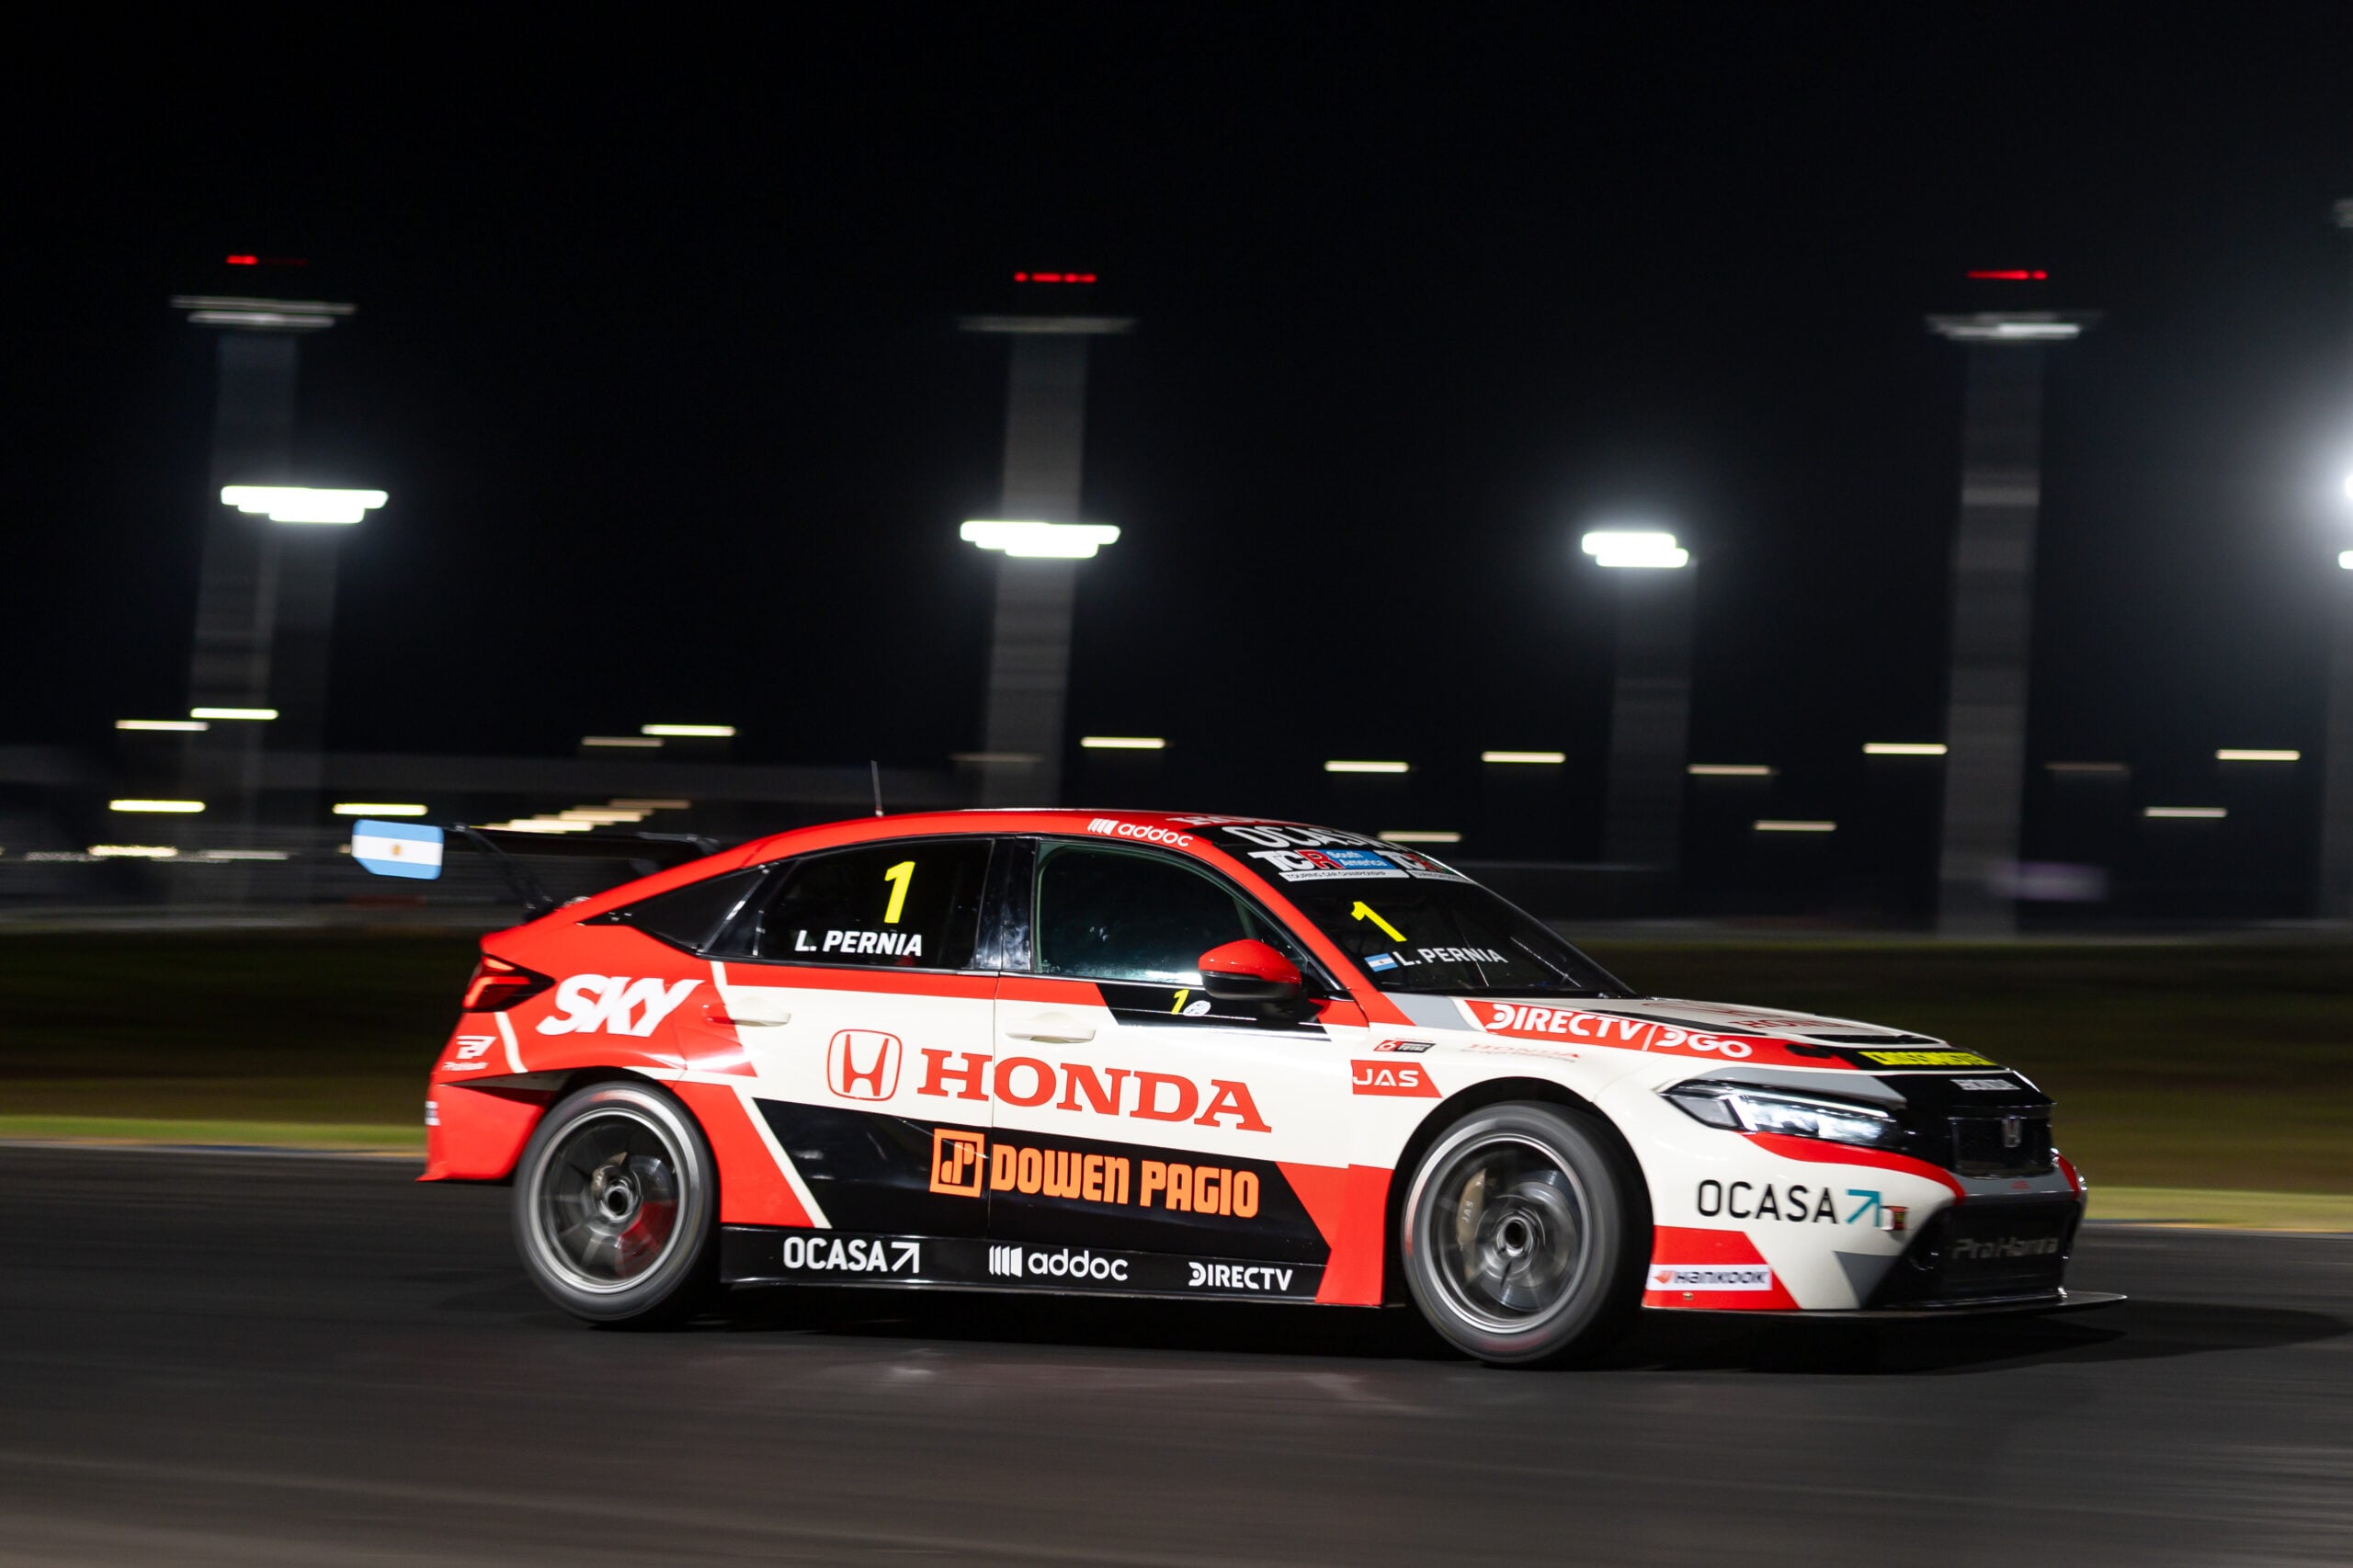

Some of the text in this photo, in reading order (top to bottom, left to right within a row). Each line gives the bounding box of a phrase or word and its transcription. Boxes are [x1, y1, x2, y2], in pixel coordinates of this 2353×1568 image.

[1118, 824, 1193, 846] addoc
[884, 860, 916, 925] 1
[1350, 901, 1407, 942] 1
[794, 929, 923, 957] L. PERNIA
[1392, 948, 1509, 966] L. PERNIA
[536, 973, 705, 1038] SKY
[1171, 988, 1189, 1016] 1
[1485, 1003, 1646, 1041] DIRECTV
[917, 1048, 1272, 1133] HONDA
[1353, 1068, 1419, 1088] JAS
[990, 1143, 1259, 1219] DOWEN PAGIO
[1698, 1179, 1838, 1224] OCASA
[783, 1236, 889, 1272] OCASA
[1029, 1247, 1129, 1281] addoc
[1188, 1261, 1293, 1291] DIRECTV
